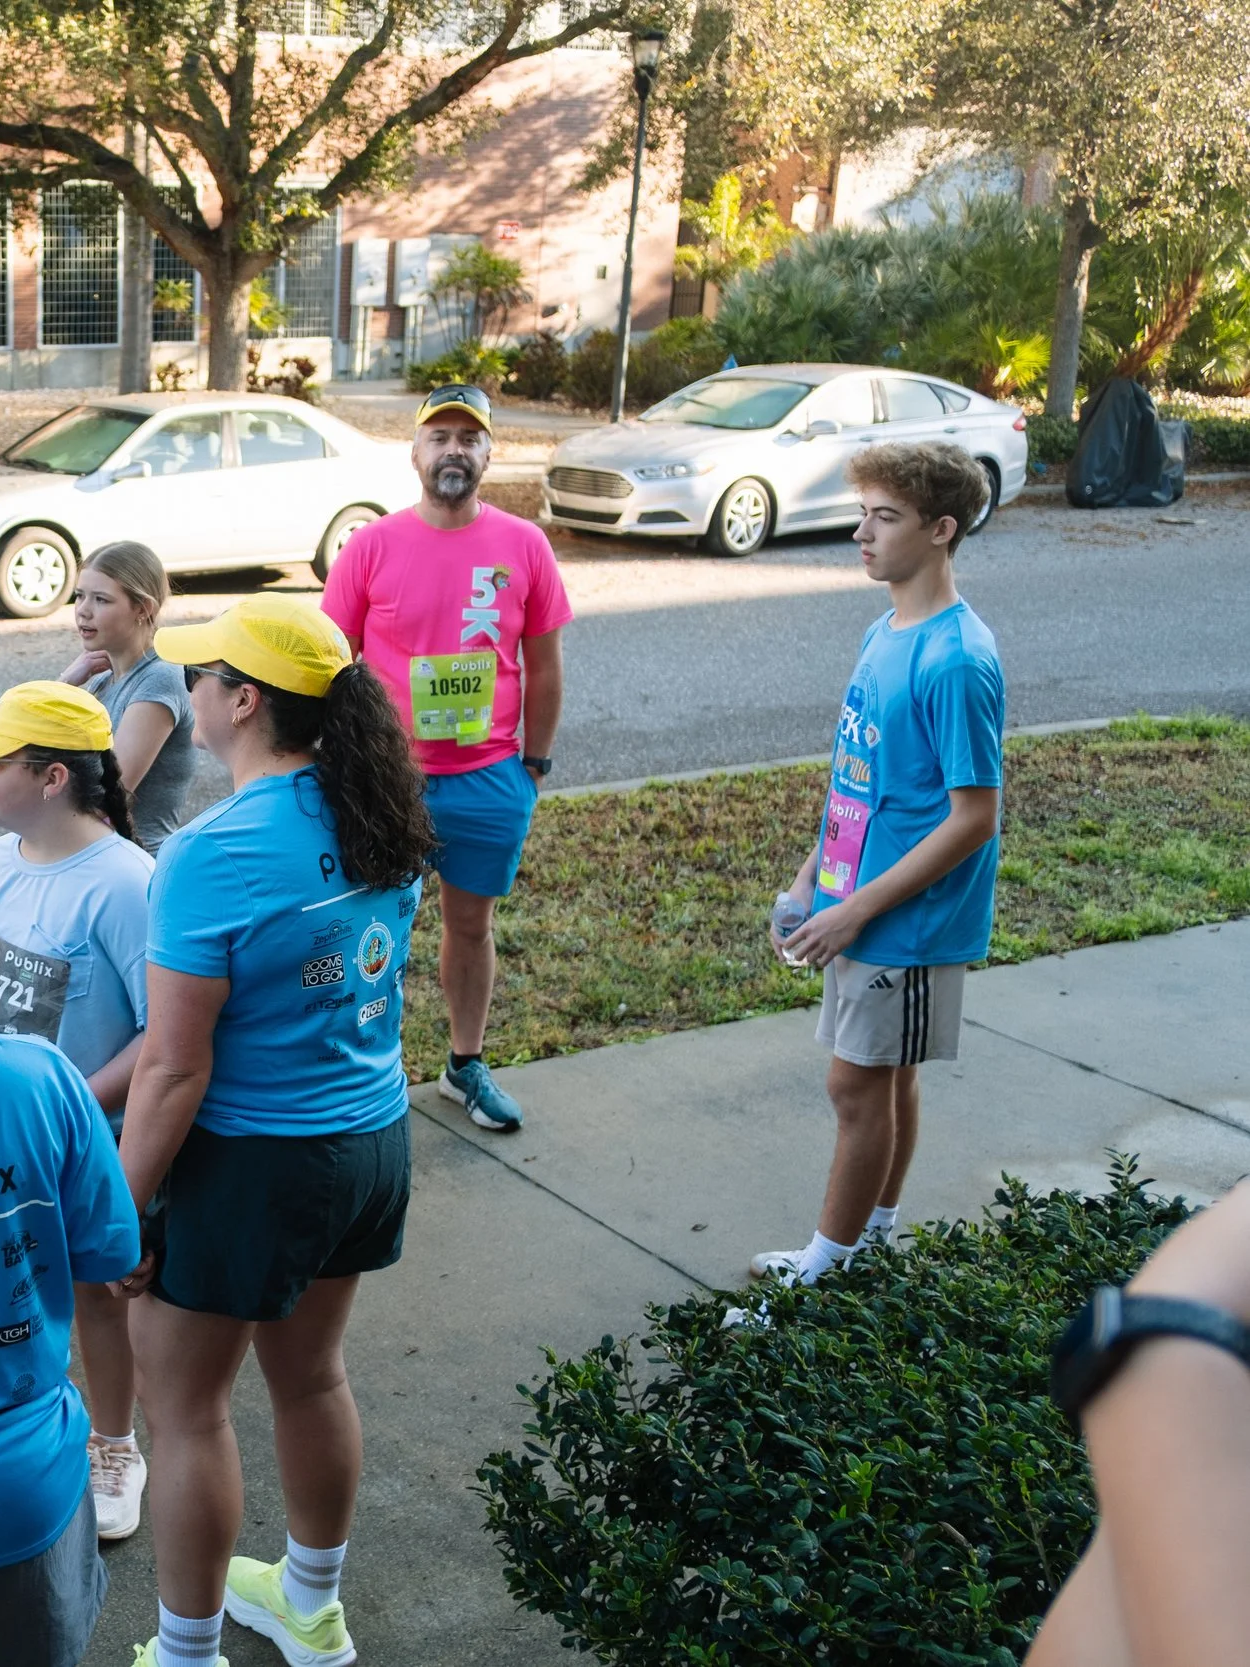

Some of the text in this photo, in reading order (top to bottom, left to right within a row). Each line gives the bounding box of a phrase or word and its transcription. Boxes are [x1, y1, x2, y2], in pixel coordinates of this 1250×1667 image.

[430, 676, 482, 697] 10502
[303, 954, 343, 972] ROOMS
[304, 969, 340, 986] TO GO
[359, 1000, 385, 1024] Q105
[3, 1323, 30, 1340] TGH
